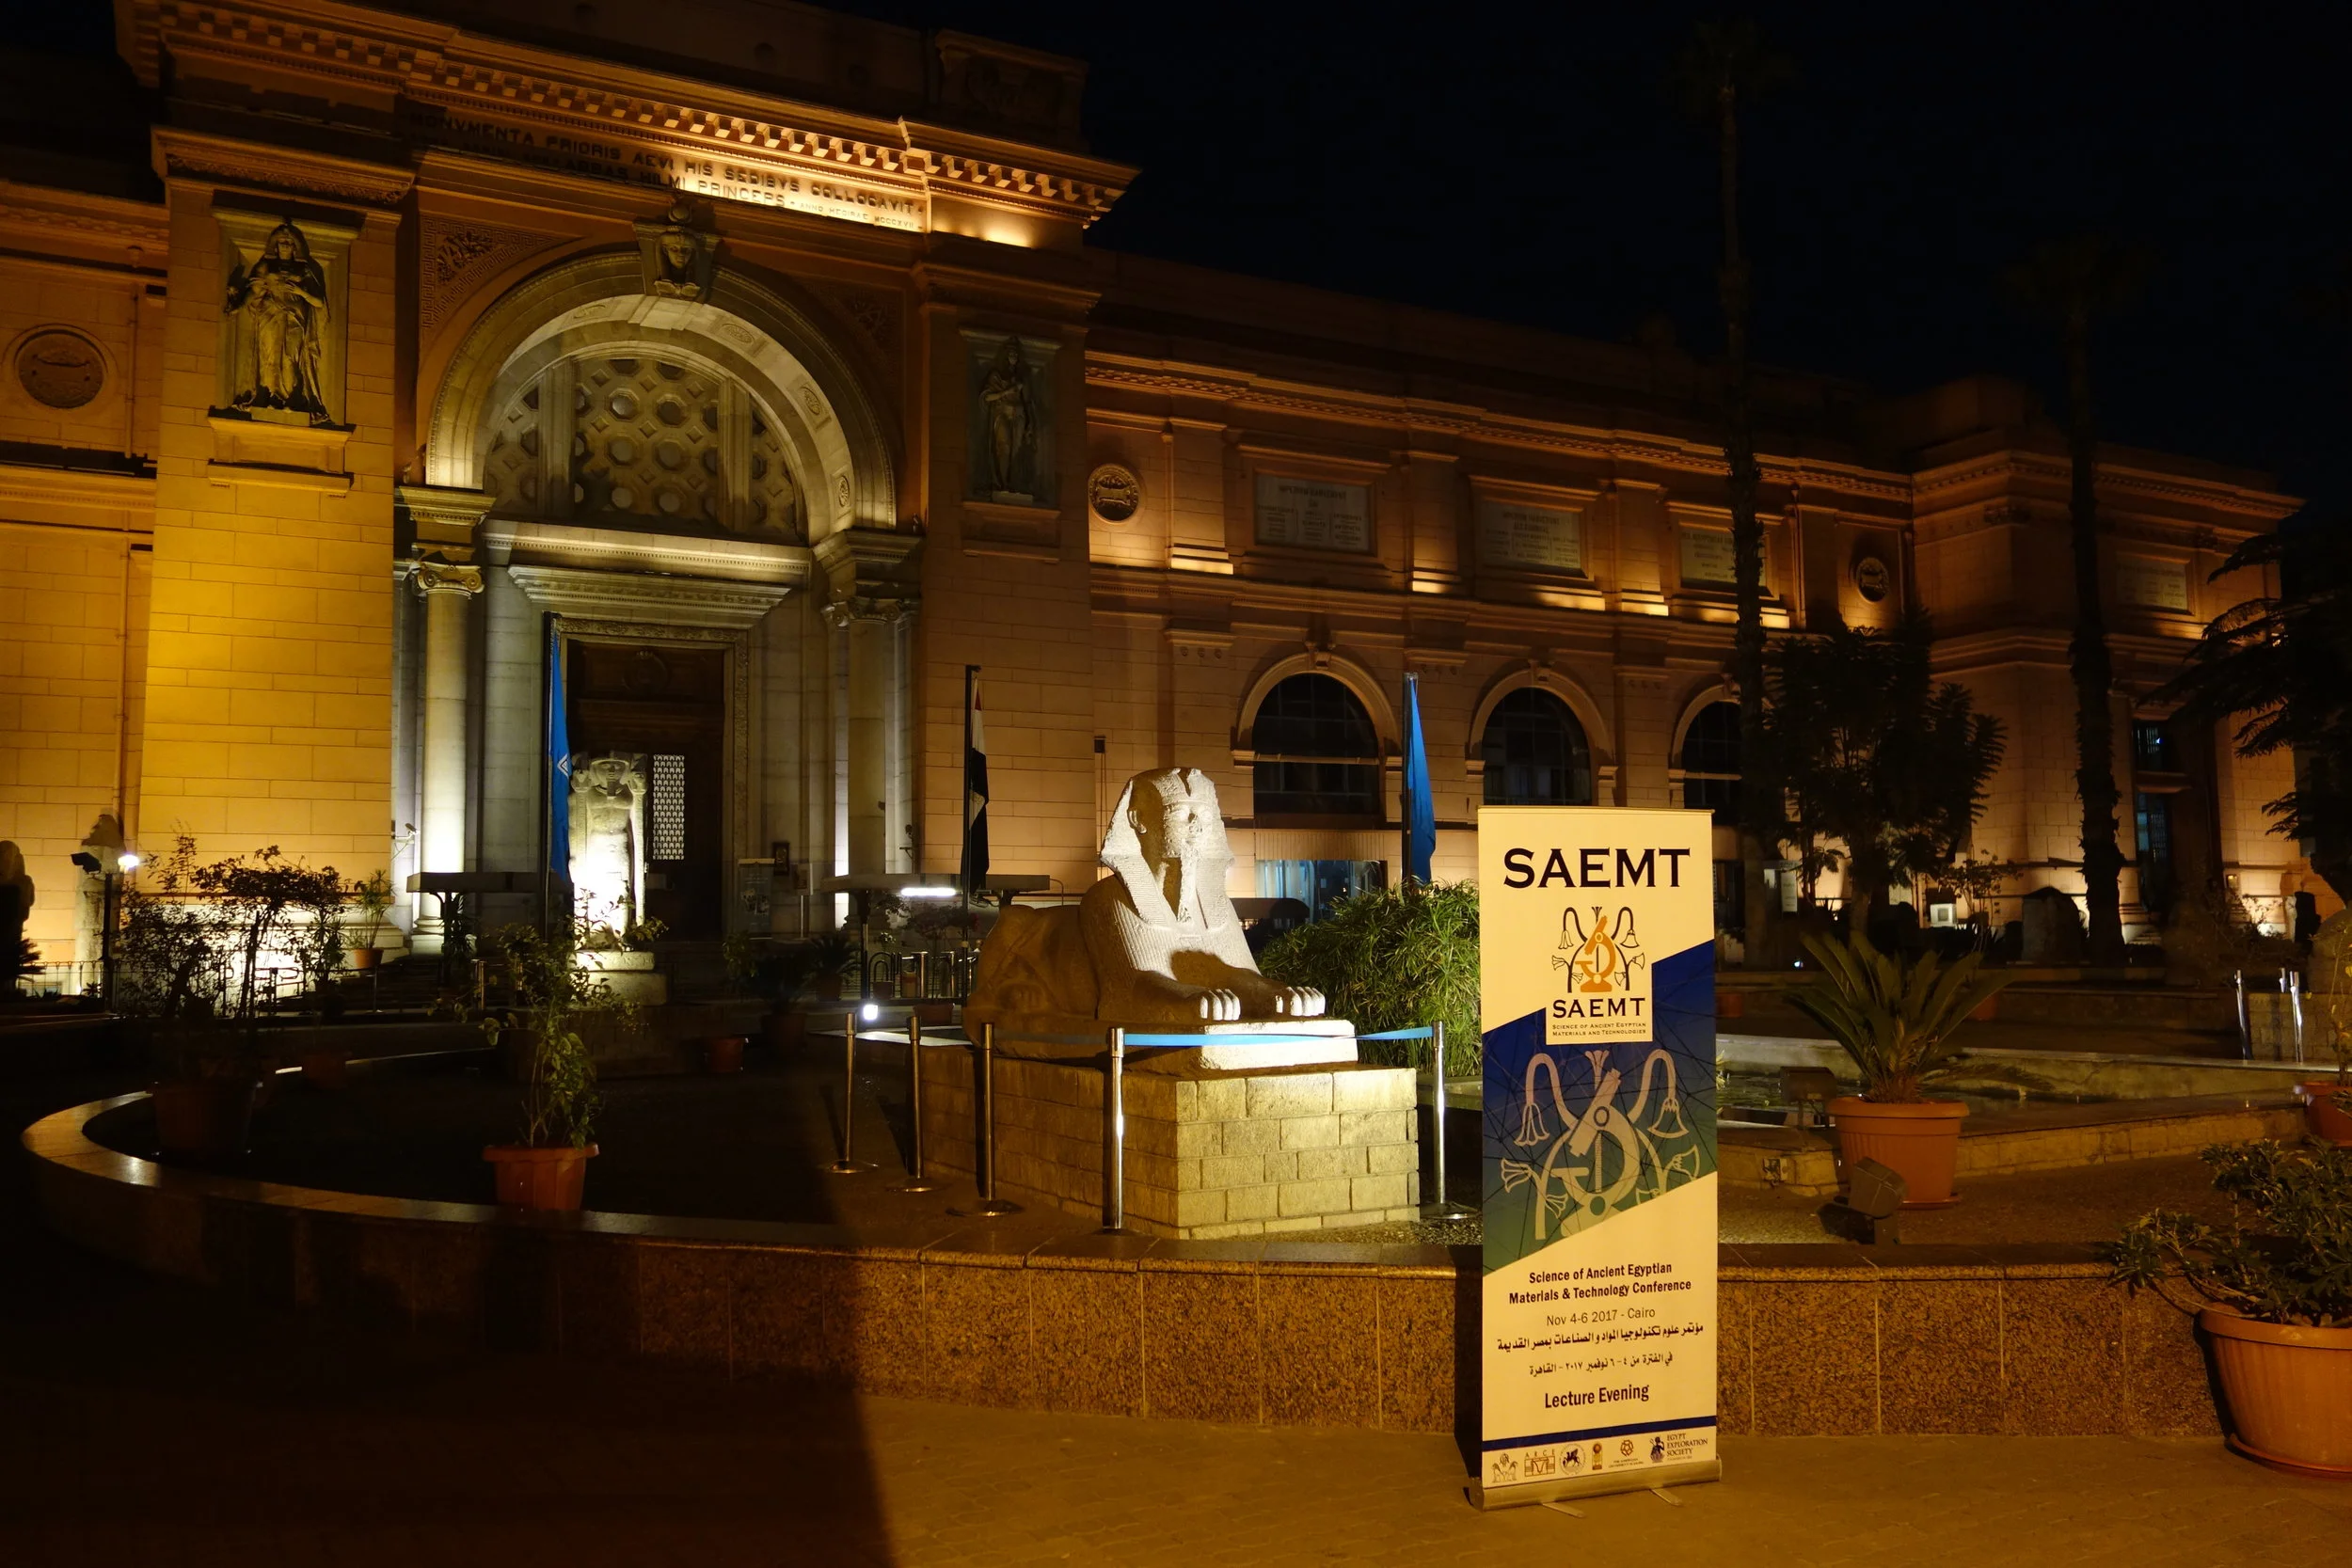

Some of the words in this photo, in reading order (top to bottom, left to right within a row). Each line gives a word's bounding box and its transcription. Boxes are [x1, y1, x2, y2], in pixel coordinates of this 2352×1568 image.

[546, 135, 621, 160] PRIORIS
[632, 151, 675, 171] AEVI
[685, 161, 713, 177] HIS
[723, 166, 800, 193] SEDIBVS
[811, 180, 914, 215] COLLOCAVIT
[698, 180, 785, 207] PRINCEPS
[1503, 847, 1691, 889] SAEMT
[1552, 998, 1645, 1019] SAEMT
[1529, 1271, 1570, 1284] Science
[1573, 1267, 1584, 1280] of
[1585, 1265, 1625, 1279] Ancient
[1628, 1262, 1672, 1277] Egyptian
[1509, 1289, 1559, 1305] Materials
[1562, 1288, 1570, 1300] &
[1573, 1284, 1629, 1299] Technology
[1632, 1280, 1692, 1294] Conference
[1547, 1315, 1566, 1327] Nov
[1570, 1312, 1588, 1324] 4-6
[1592, 1309, 1617, 1323] 2017
[1628, 1307, 1656, 1320] Cairo
[1601, 1329, 1619, 1343] المواد
[1620, 1325, 1661, 1341] تكنولوجيا
[1662, 1324, 1679, 1338] علوم
[1681, 1323, 1704, 1336] مؤتمر
[1497, 1338, 1530, 1353] القديمة
[1532, 1338, 1552, 1351] بمصر
[1565, 1361, 1582, 1370] ٢٠١٧
[1586, 1357, 1609, 1373] نوفمبر
[1630, 1355, 1640, 1368] من
[1643, 1353, 1664, 1366] الفترة
[1664, 1352, 1673, 1367] في
[1529, 1362, 1557, 1378] القاهرة
[1545, 1391, 1595, 1409] Lecture
[1598, 1384, 1650, 1402] Evening
[1667, 1433, 1686, 1442] EGYPT
[1667, 1438, 1708, 1449] EXPLORATION
[1667, 1448, 1693, 1457] SOCIETY
